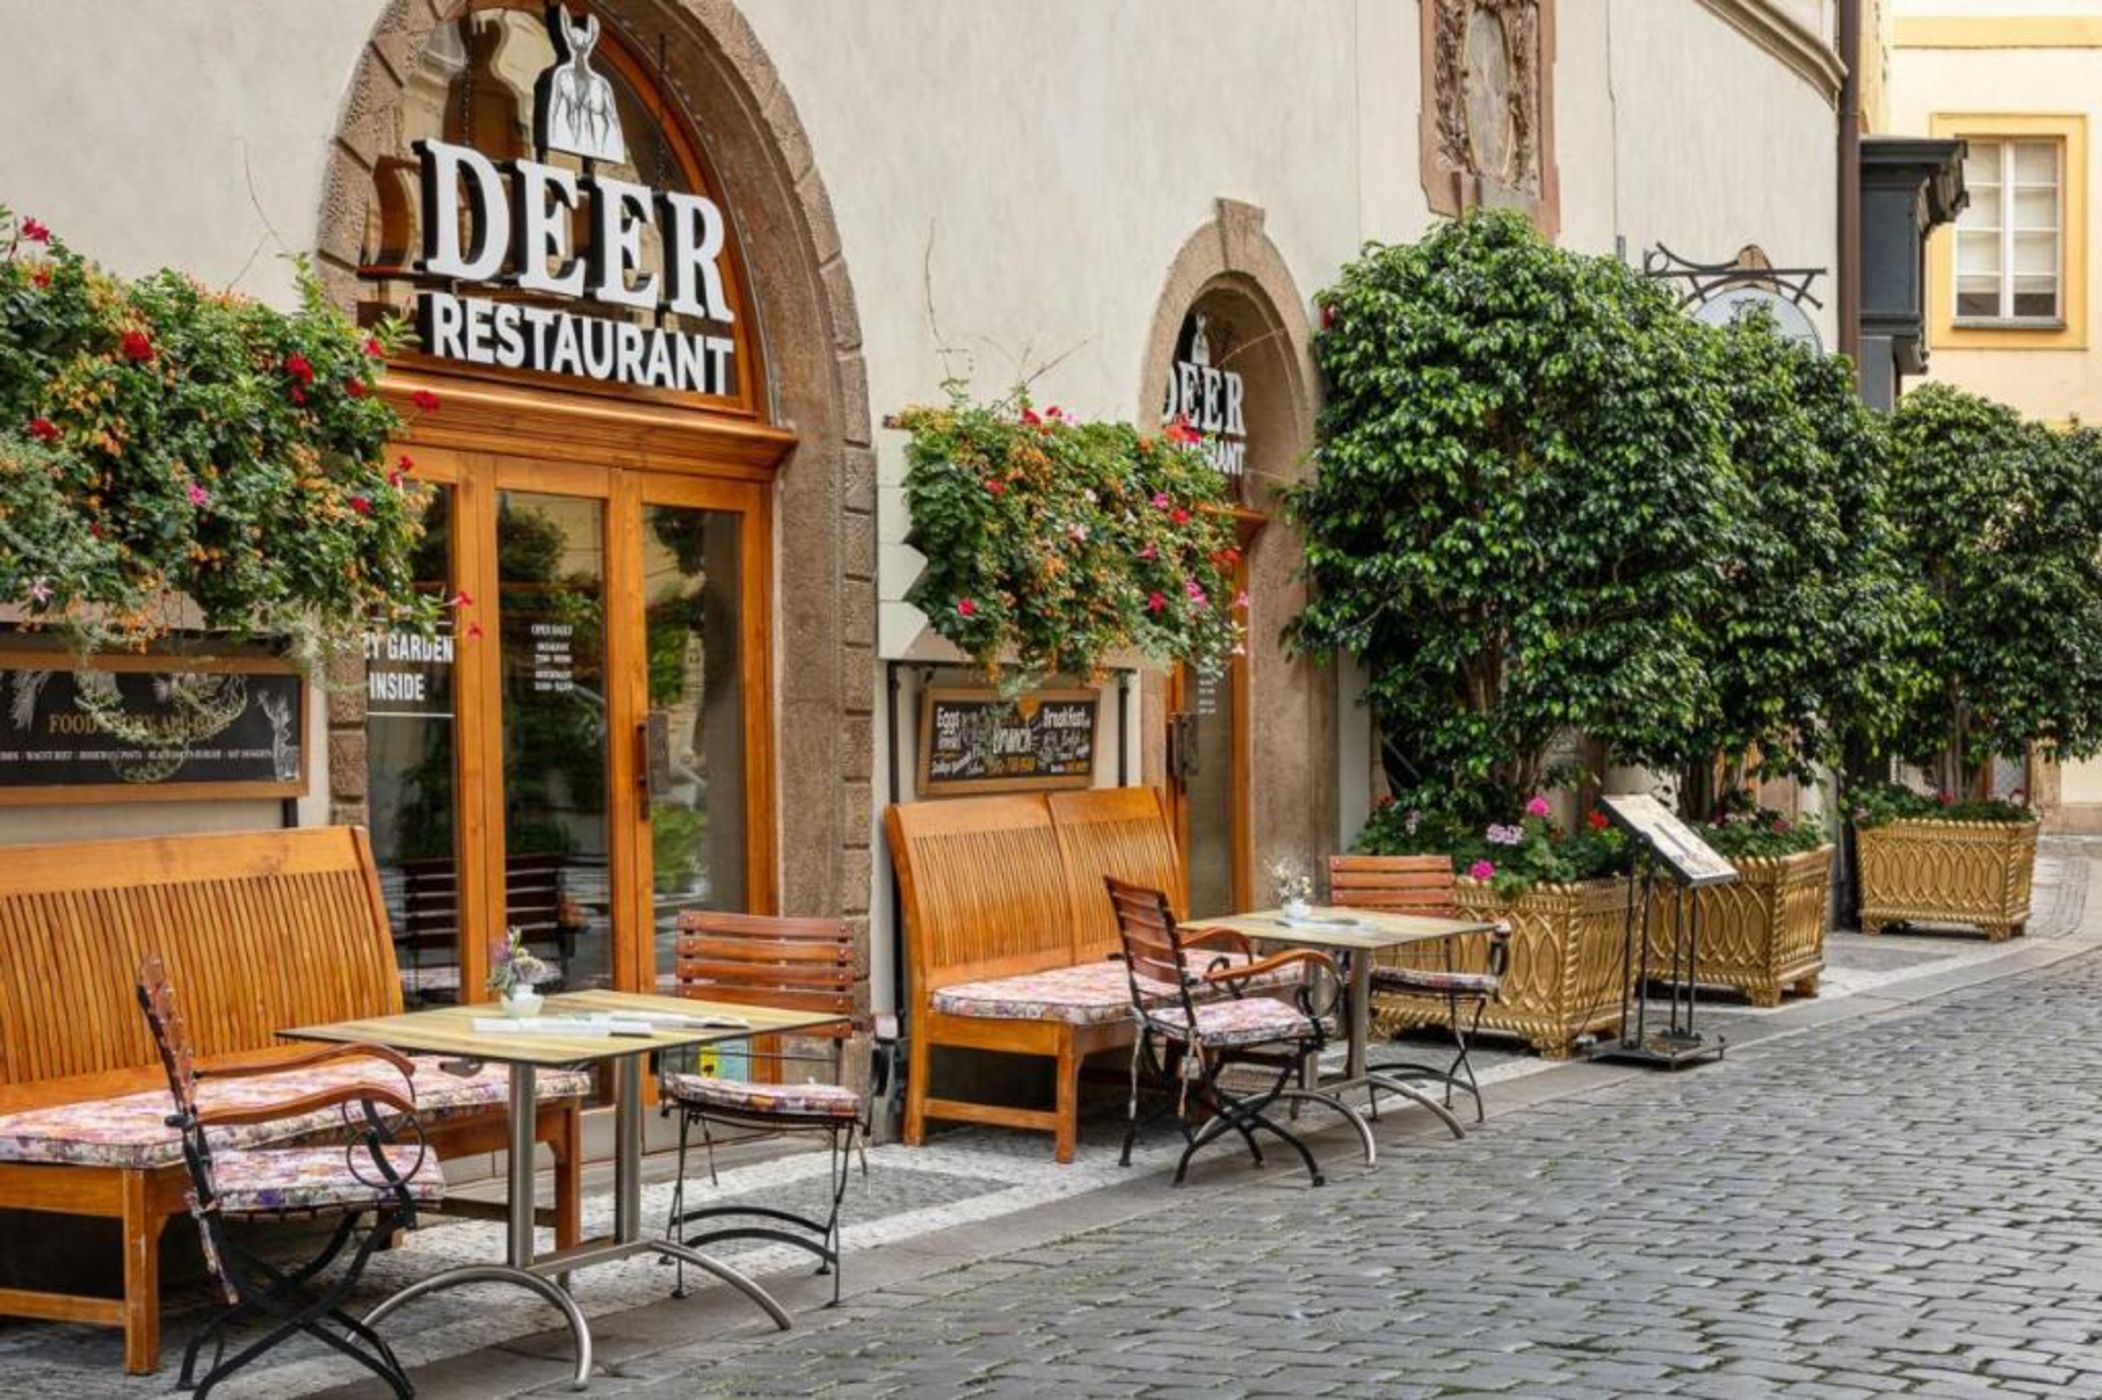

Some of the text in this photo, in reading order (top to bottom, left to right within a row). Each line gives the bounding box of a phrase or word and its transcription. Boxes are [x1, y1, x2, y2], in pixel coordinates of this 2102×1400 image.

[421, 138, 736, 322] DEER
[431, 293, 735, 396] RESTAURANT
[387, 634, 454, 662] GARDEN
[369, 672, 425, 701] INSIDE
[49, 713, 98, 735] FOOD
